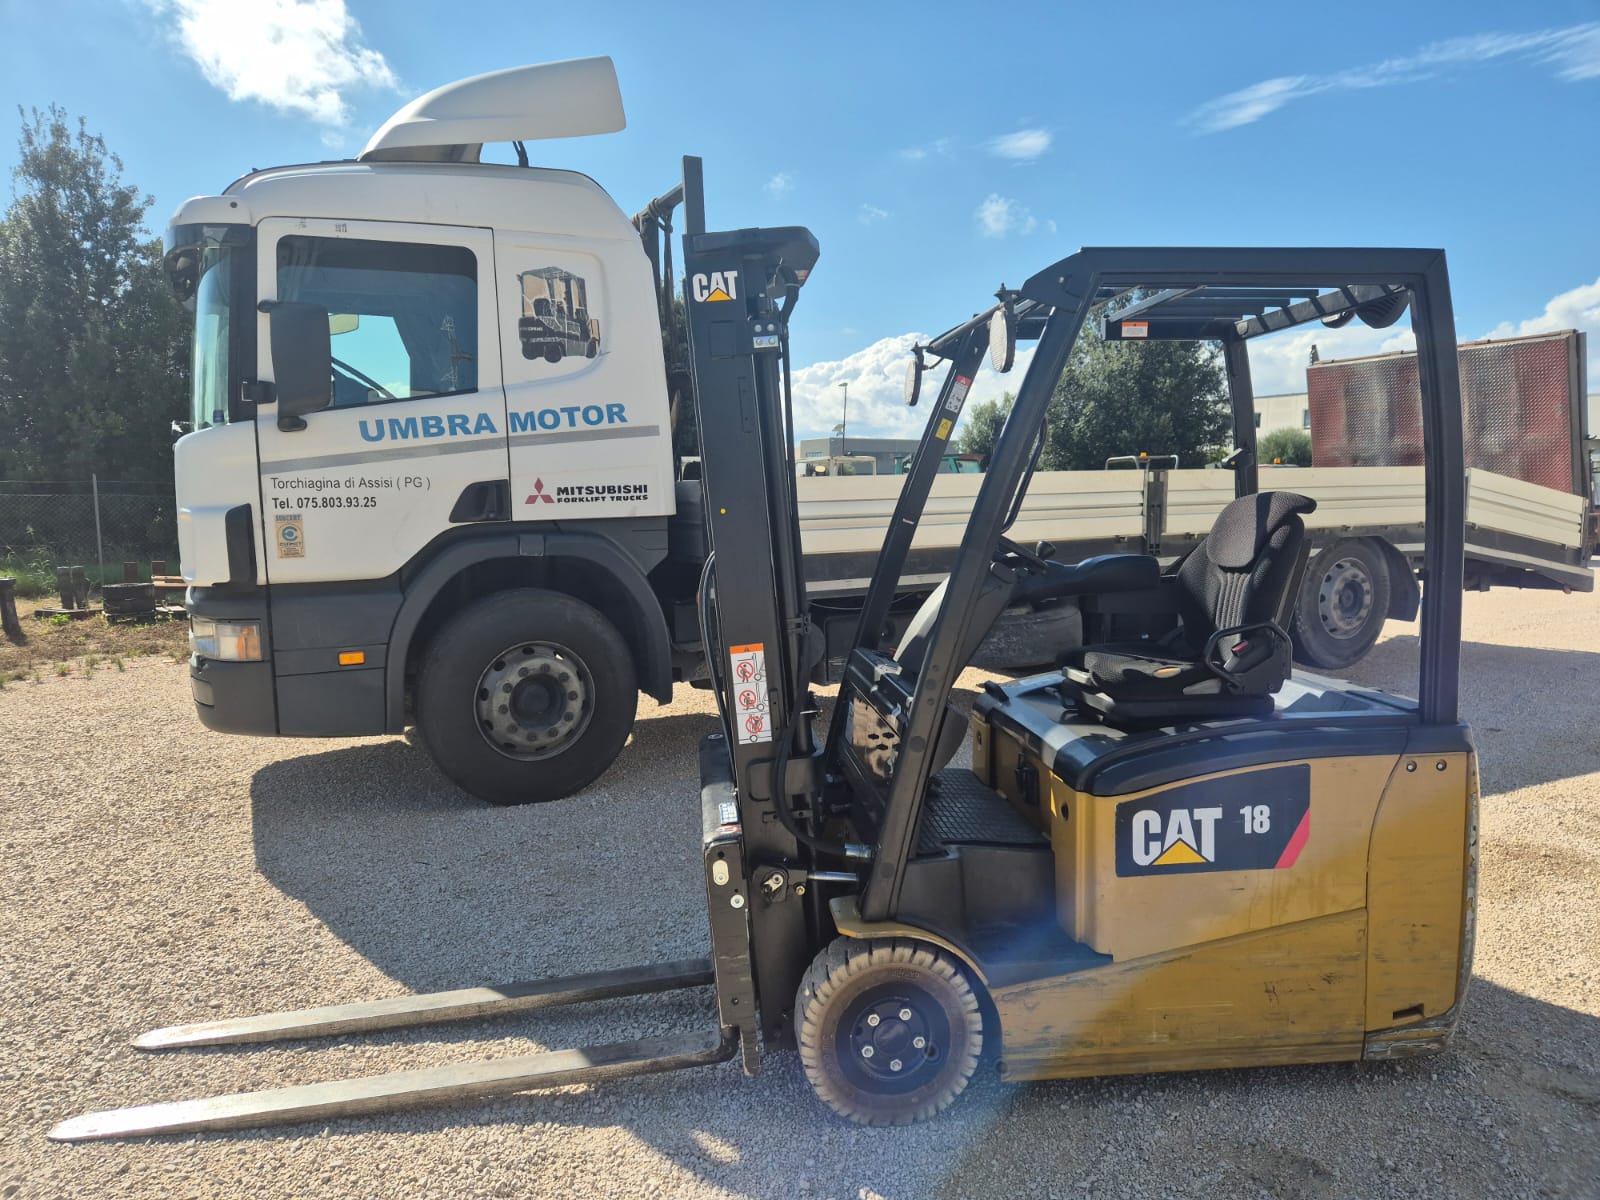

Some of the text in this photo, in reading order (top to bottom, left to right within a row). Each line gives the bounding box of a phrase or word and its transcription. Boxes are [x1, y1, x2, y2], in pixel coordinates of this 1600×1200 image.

[692, 270, 738, 303] CAT
[358, 403, 628, 442] UMBRA MOTOR
[270, 476, 341, 491] Torchiagina
[344, 476, 355, 489] di
[358, 476, 393, 489] Assisi
[556, 484, 648, 496] MITSUBISHI
[272, 496, 377, 509] Tel. 075.803.93.25
[610, 494, 648, 502] TRUCKS
[1132, 804, 1271, 866] CAT 18
